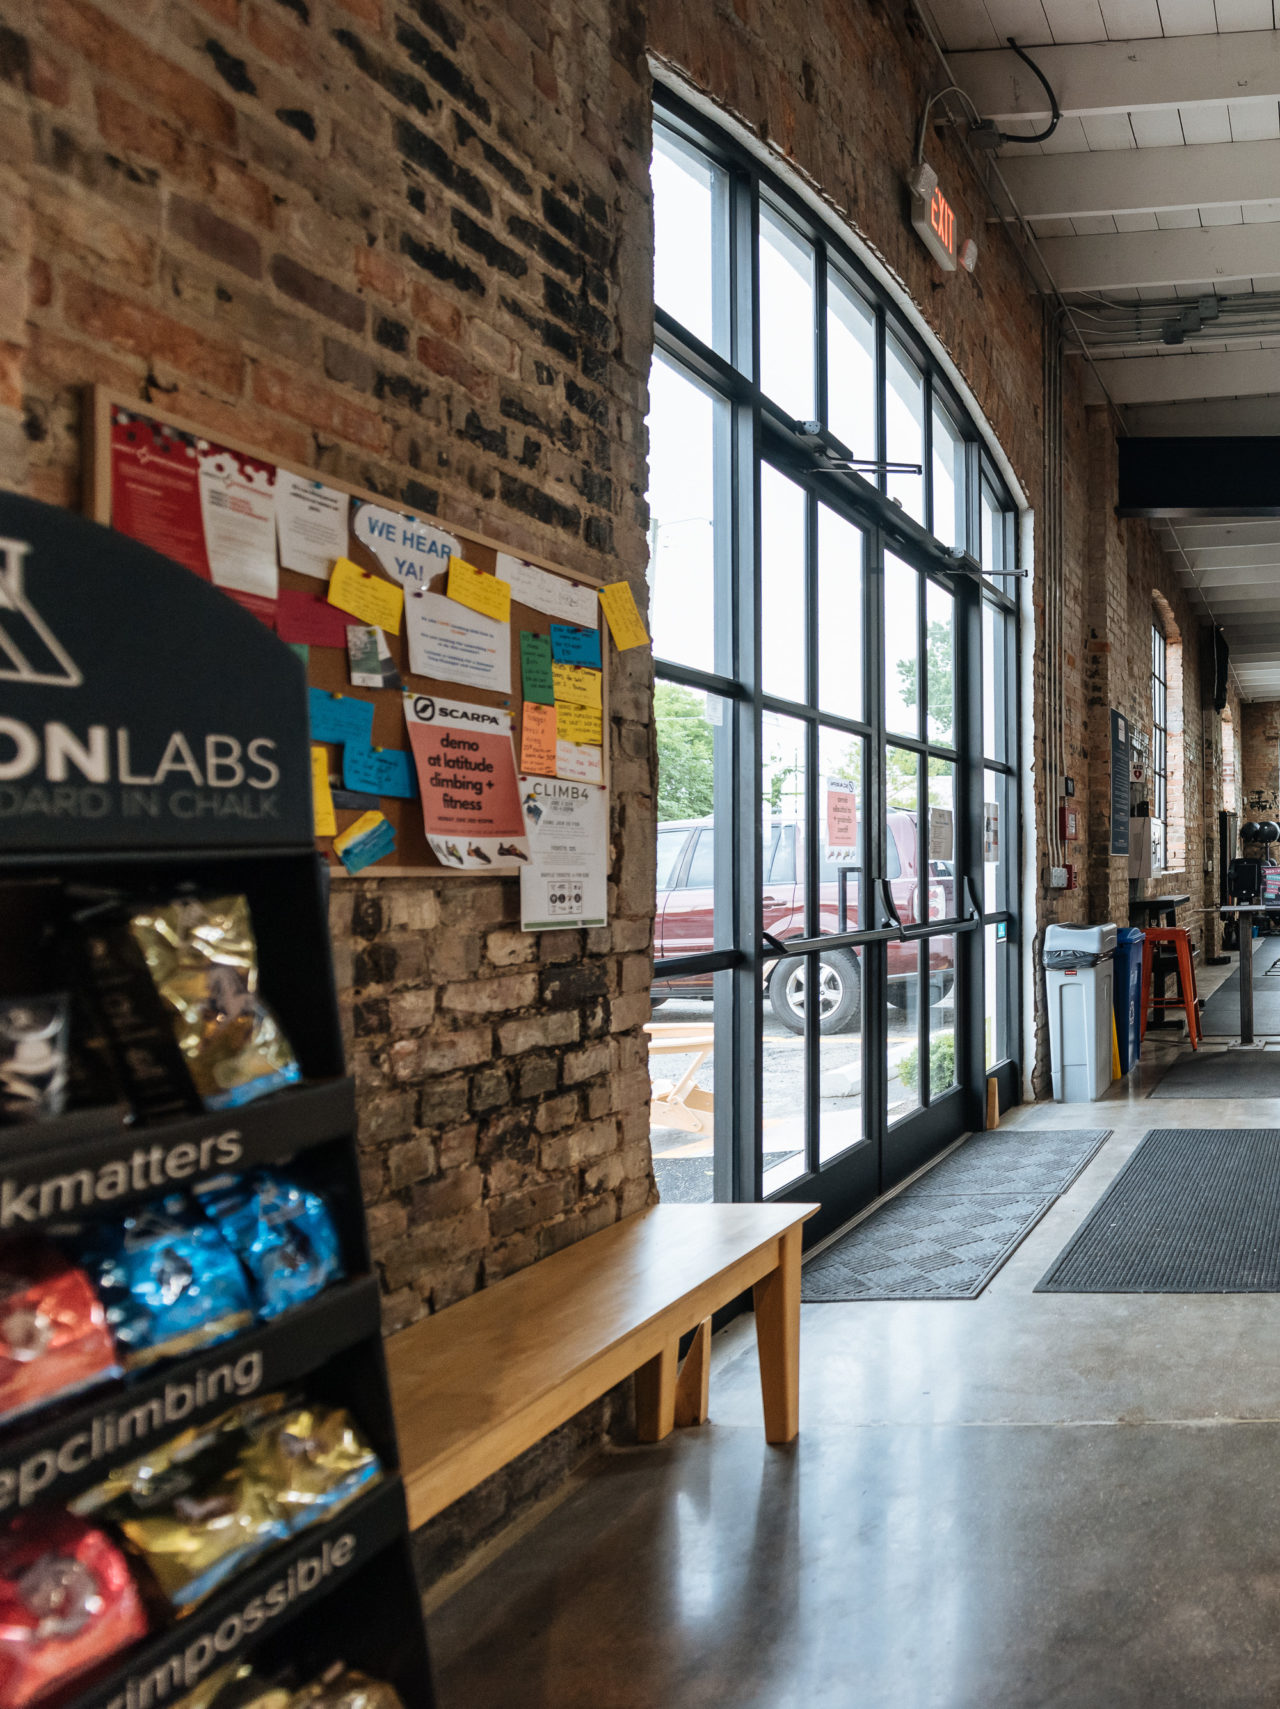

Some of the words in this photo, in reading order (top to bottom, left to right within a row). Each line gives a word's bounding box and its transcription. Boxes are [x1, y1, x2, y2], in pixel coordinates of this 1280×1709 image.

[931, 186, 954, 254] EXIT
[368, 516, 396, 542] WE
[402, 530, 452, 559] HEAR
[394, 556, 424, 581] YA!
[438, 707, 499, 725] SCARPA
[440, 733, 479, 751] demo
[427, 754, 441, 767] at
[443, 754, 494, 773] latitude
[429, 772, 484, 795] climbing
[533, 782, 589, 800] CLIMB4
[442, 793, 482, 811] fitness
